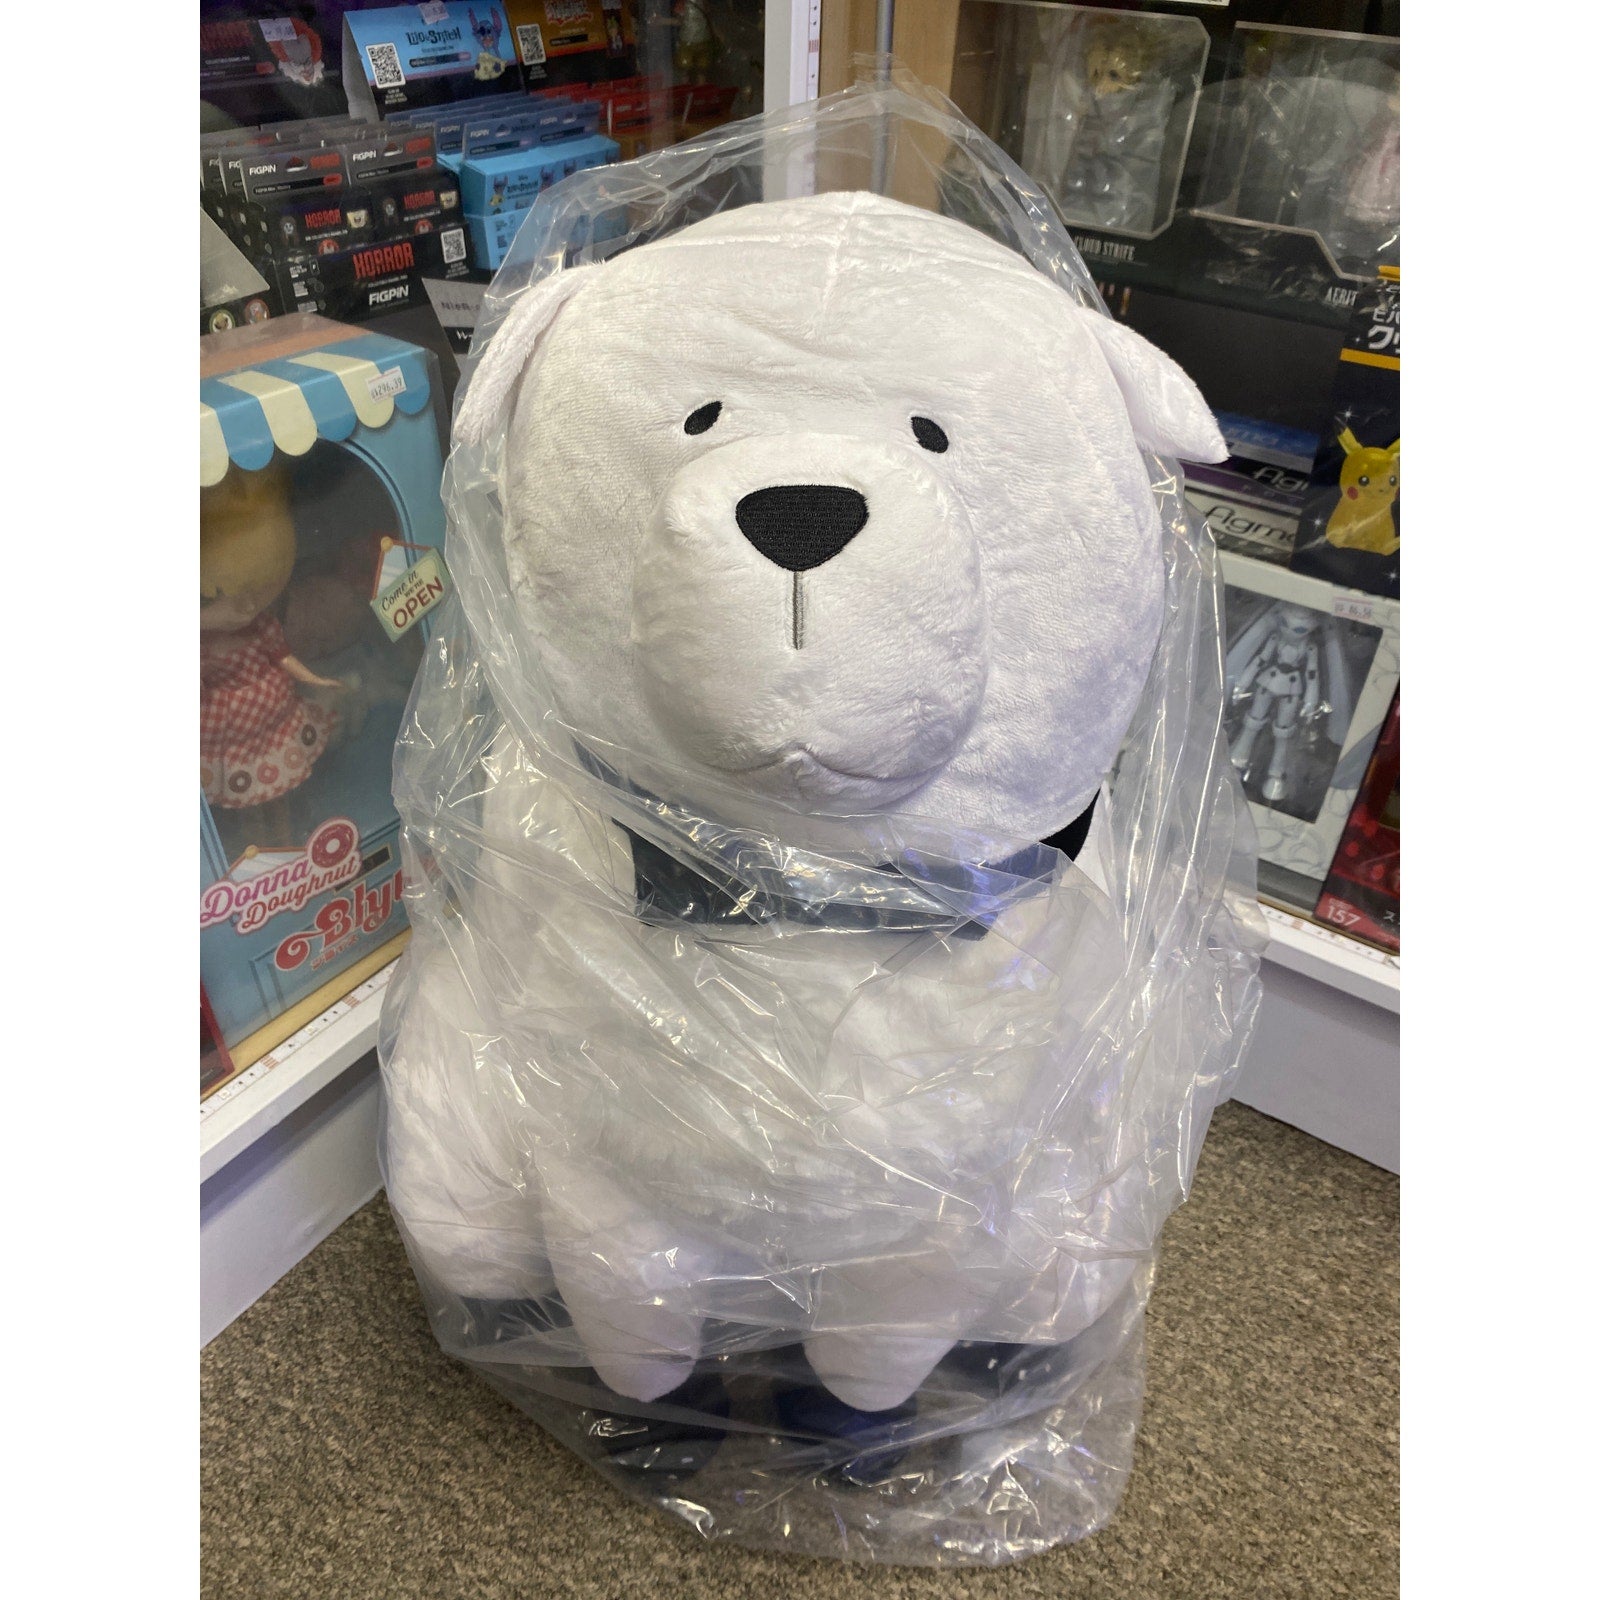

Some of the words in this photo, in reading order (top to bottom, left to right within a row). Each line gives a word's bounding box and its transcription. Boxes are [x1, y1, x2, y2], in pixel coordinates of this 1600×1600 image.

[353, 242, 415, 280] HORROR
[381, 582, 406, 611] Come
[408, 569, 418, 584] in
[393, 575, 444, 629] OPEN
[200, 857, 311, 924] Donna
[241, 855, 356, 929] Doughnut
[1327, 905, 1362, 927] 157
